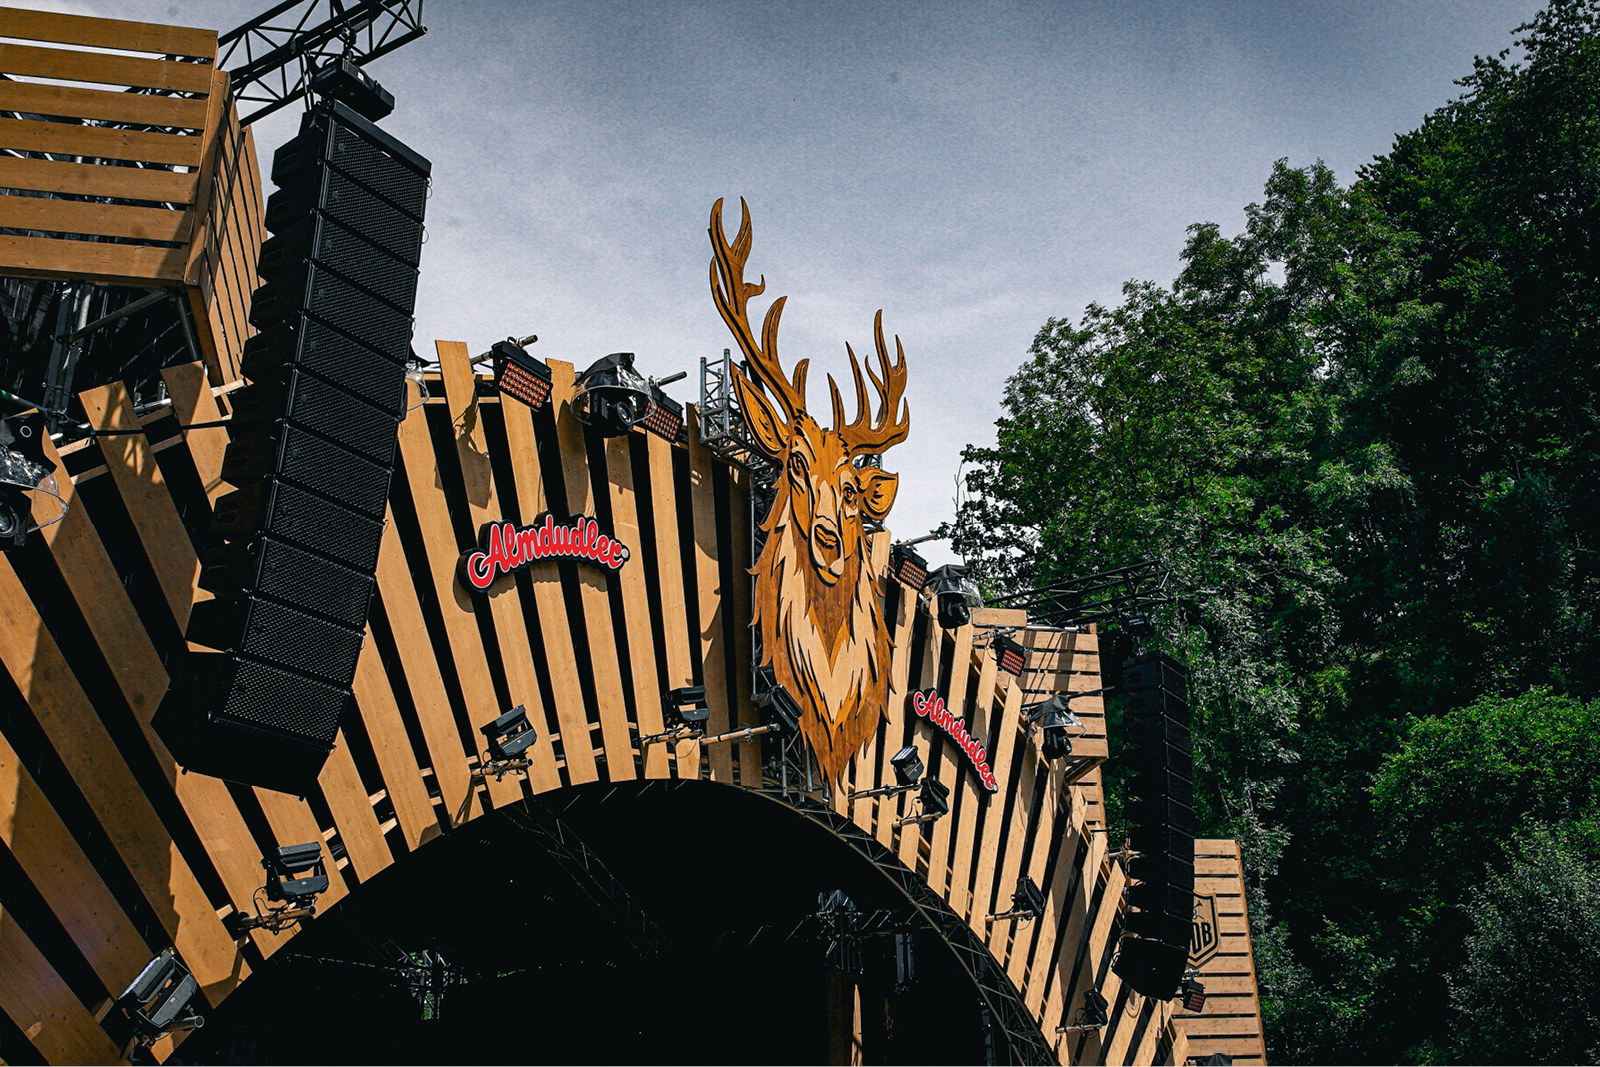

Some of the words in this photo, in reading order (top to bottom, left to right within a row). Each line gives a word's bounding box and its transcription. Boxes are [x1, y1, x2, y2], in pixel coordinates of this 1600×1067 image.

[467, 514, 624, 588] Almdudler
[913, 690, 994, 790] Almdudler
[1191, 922, 1213, 955] DB
